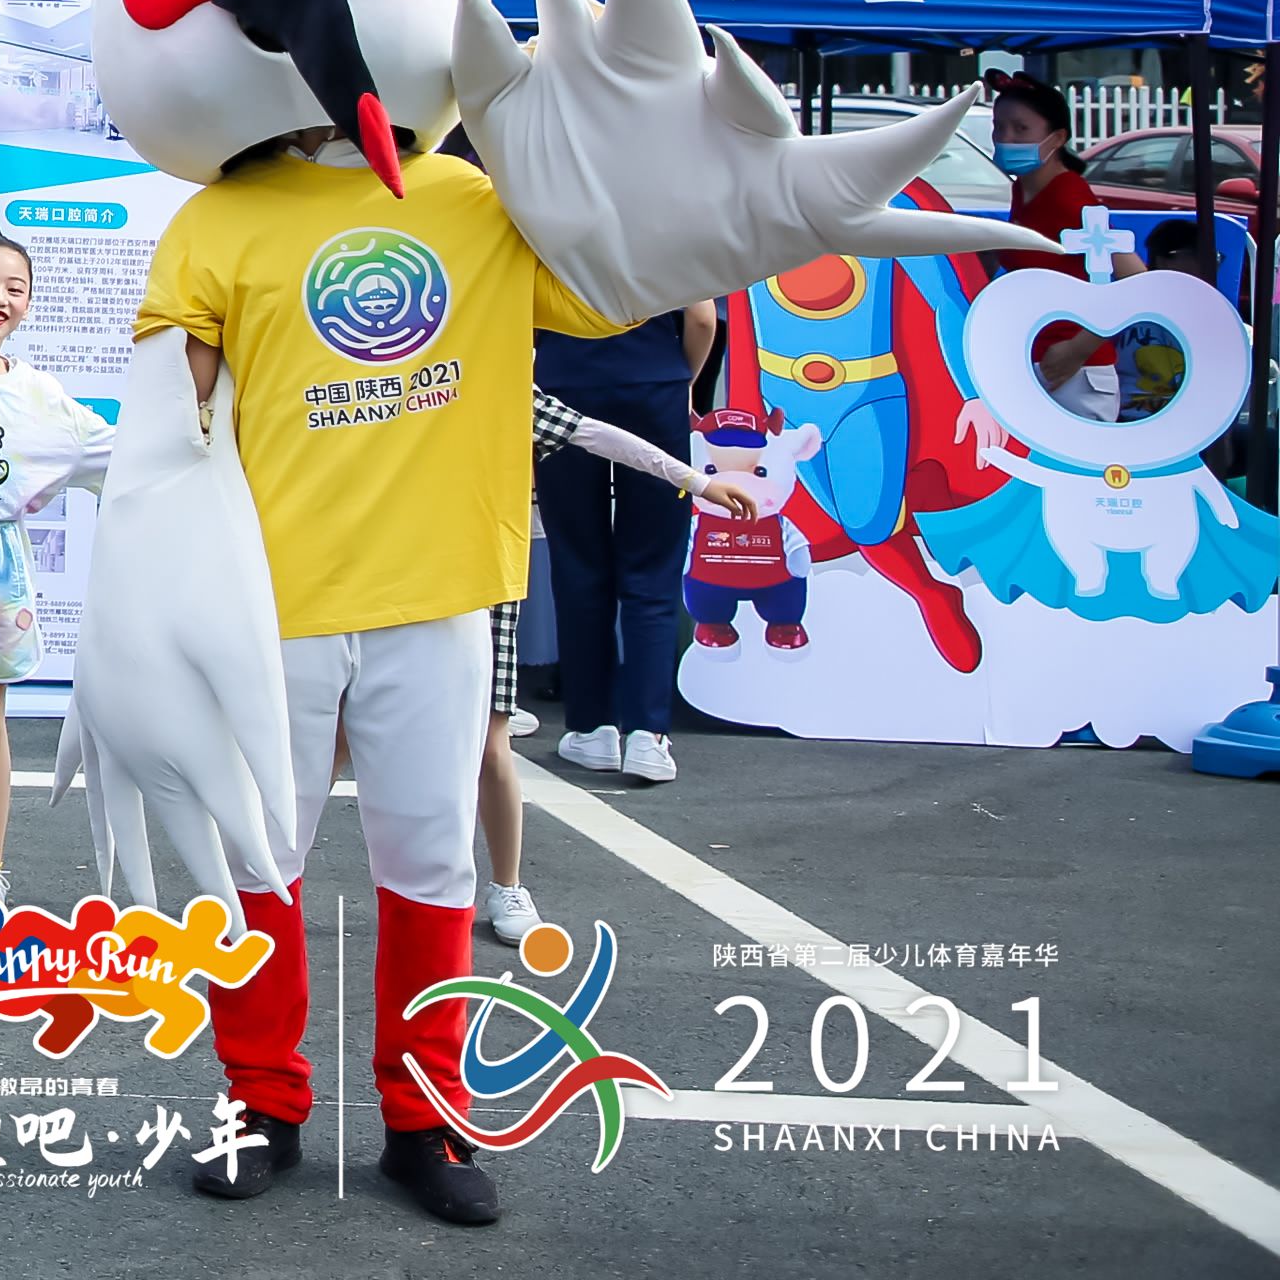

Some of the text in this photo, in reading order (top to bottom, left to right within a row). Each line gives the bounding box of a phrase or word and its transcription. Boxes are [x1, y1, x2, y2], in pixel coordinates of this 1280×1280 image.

[18, 206, 115, 224] 天瑞口腔简介
[305, 360, 461, 406] 中国 陕西 2021
[308, 402, 402, 428] SHAANXI
